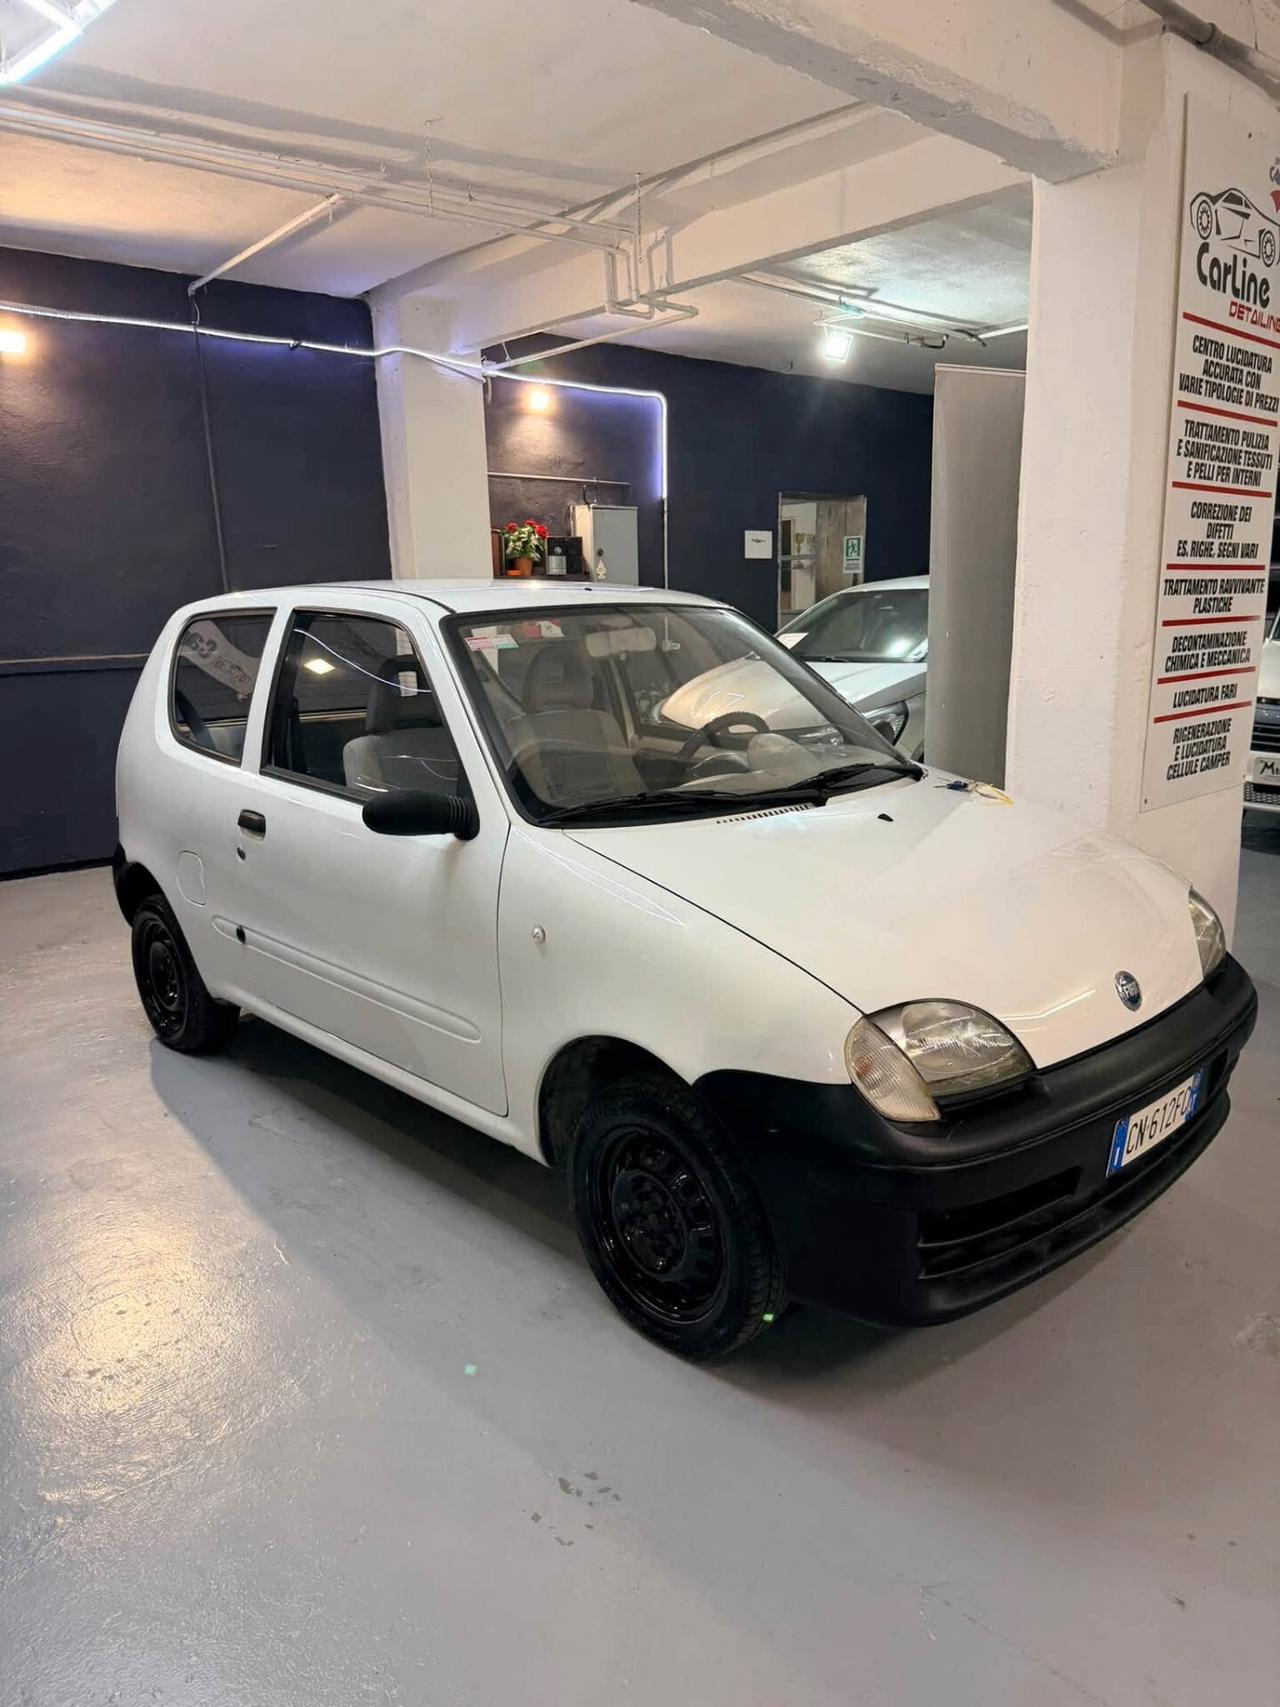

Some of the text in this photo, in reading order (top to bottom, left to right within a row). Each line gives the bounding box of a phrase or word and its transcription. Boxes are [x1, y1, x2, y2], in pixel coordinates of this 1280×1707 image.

[1196, 242, 1270, 309] CarLine
[1192, 334, 1273, 374] CENTRO LUCIDATURA
[1202, 359, 1262, 390] ACCURATA CON
[1178, 373, 1280, 413] VARIE TIPOLOGIE DI PREZZI
[1184, 419, 1270, 451] TRATTAMENTO PULIZIA
[1176, 439, 1273, 470] E SANIFICAZIONE TESSUTI
[1186, 461, 1262, 487] E PELLI PER INTERNI
[1190, 501, 1252, 523] CORREZIONE DEI
[1206, 523, 1234, 540] DIFETTI
[1176, 540, 1189, 557] ES.
[1216, 542, 1240, 559] SEGNI
[1240, 543, 1259, 559] VARI
[1163, 578, 1266, 596] TRATTAMENTO RAVVIVANTE
[1193, 597, 1233, 614] PLASTICHE
[1171, 631, 1248, 653] DECONTAMINAZIONE
[1165, 648, 1251, 673] CHIMICA E MECCANICA
[1172, 683, 1238, 708] LUCIDATURA FARI
[1173, 718, 1232, 744] RIGENERAZIONE
[1174, 735, 1227, 762] E LUCIDATURA
[1166, 751, 1231, 780] CELLULE CAMPER
